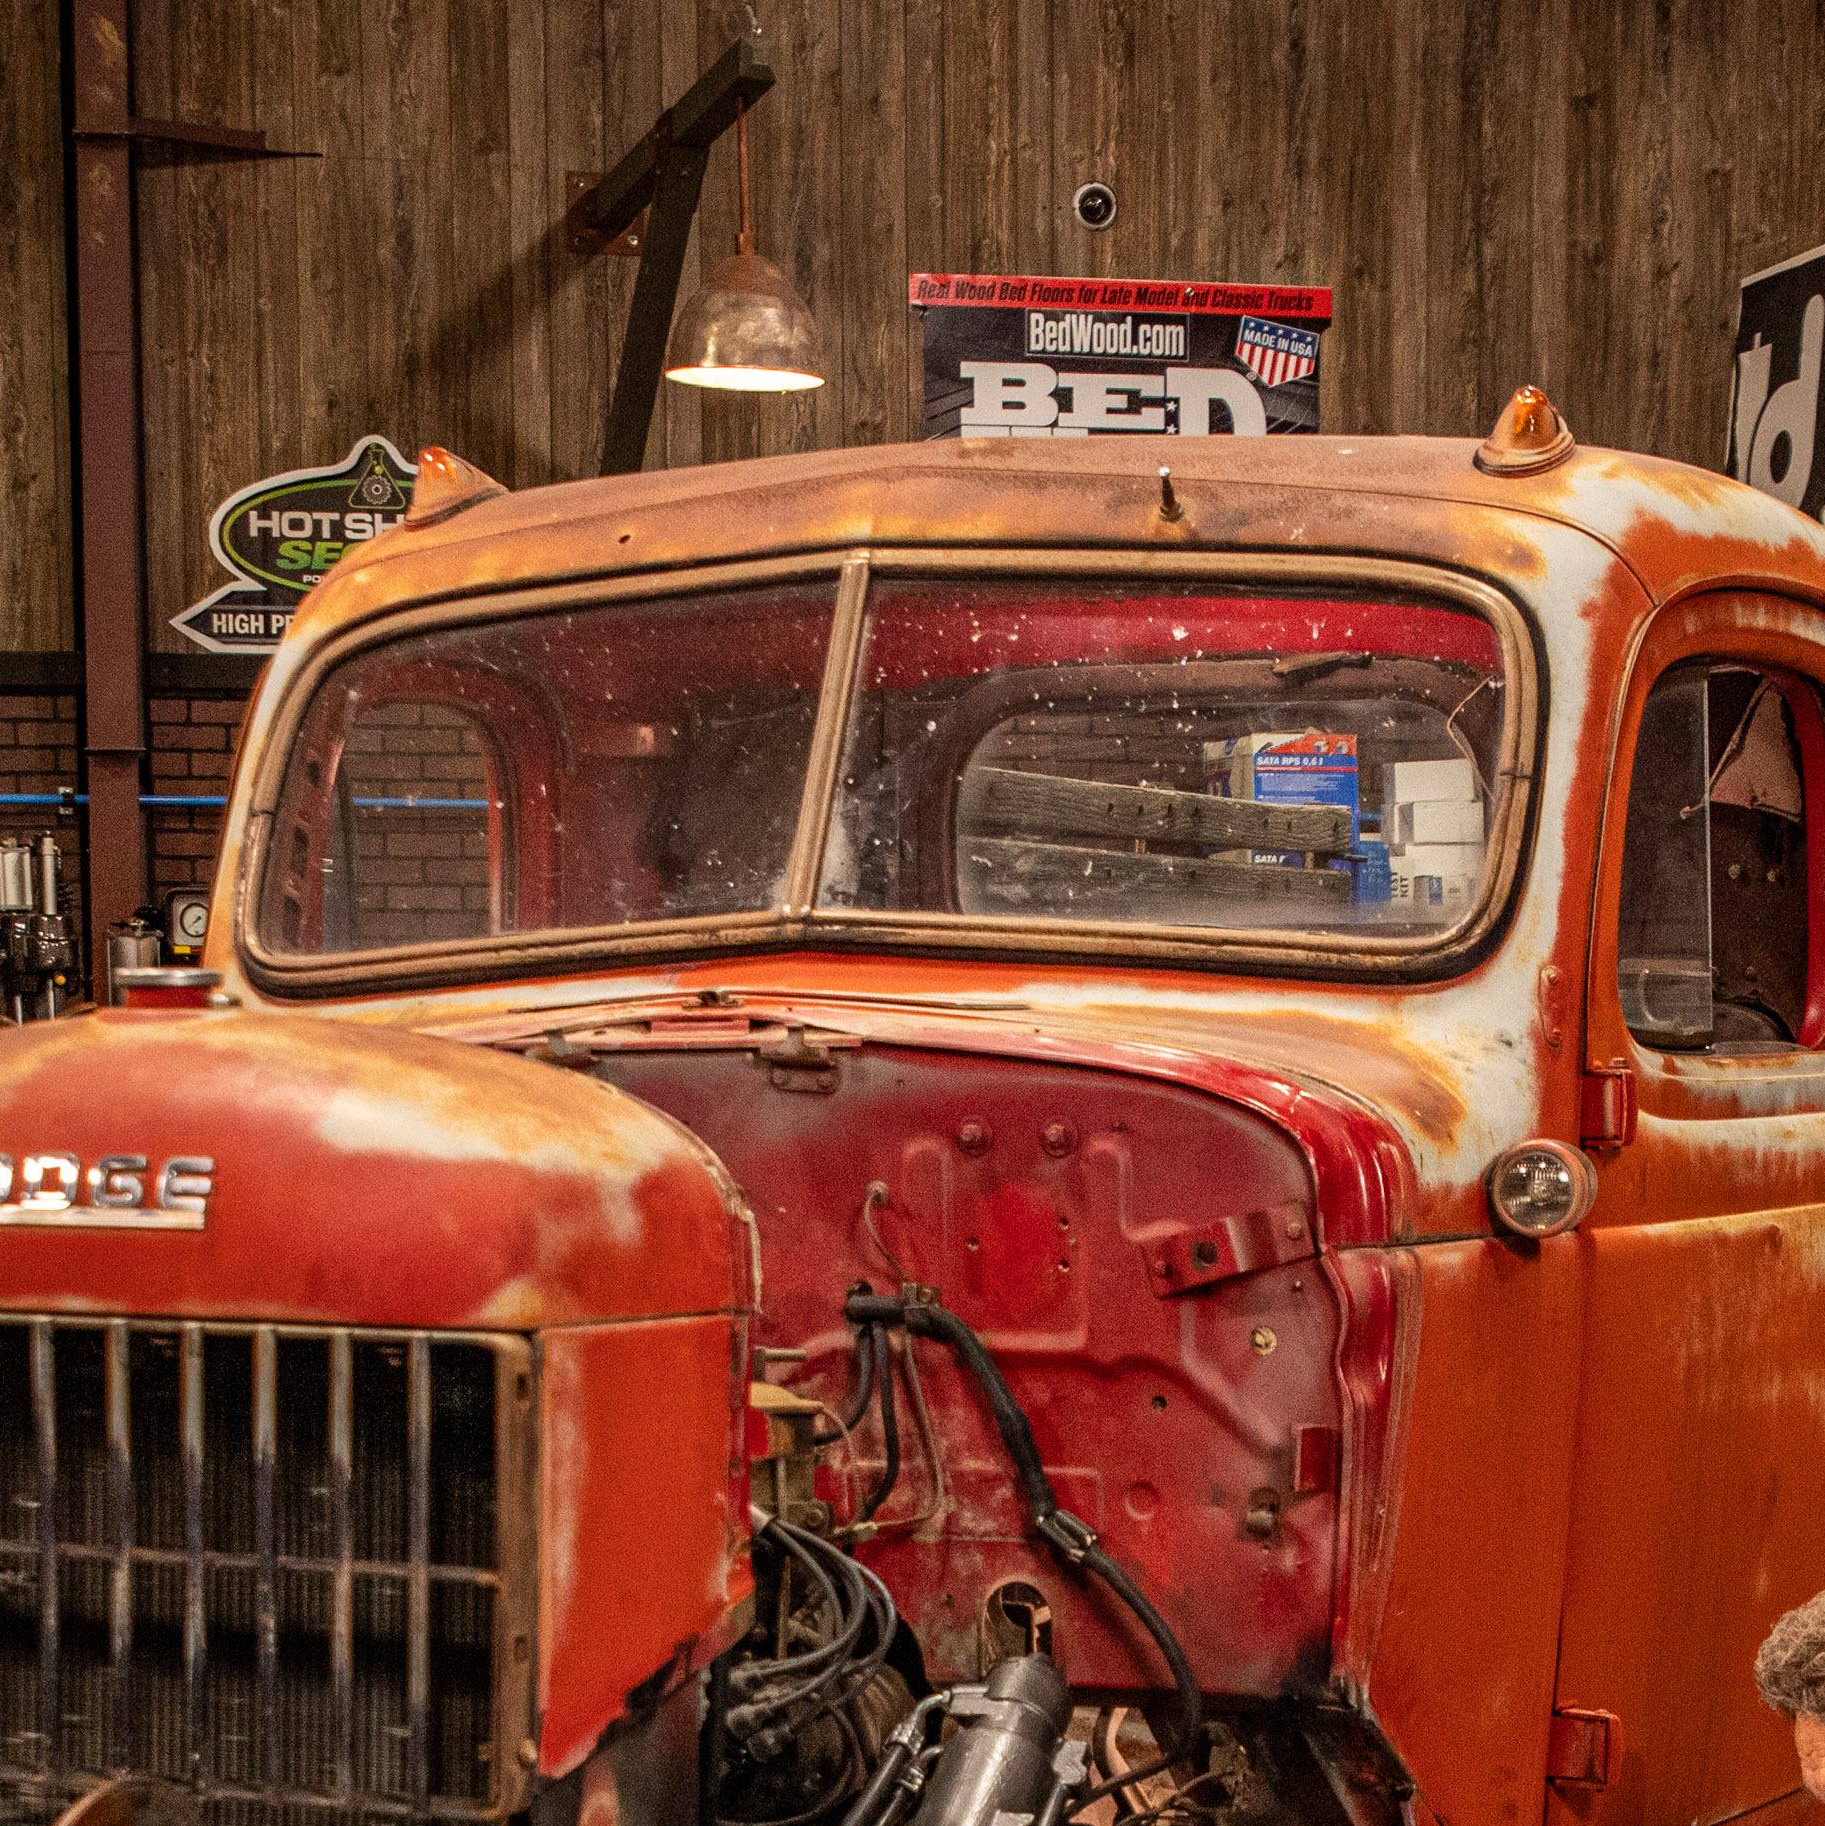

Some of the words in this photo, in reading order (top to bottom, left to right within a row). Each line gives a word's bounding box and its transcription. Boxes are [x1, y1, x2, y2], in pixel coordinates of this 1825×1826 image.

[918, 279, 950, 299] Real
[955, 281, 996, 301] Wood
[999, 282, 1028, 301] Bed
[1030, 283, 1073, 303] Floors
[1078, 285, 1098, 303] for
[1101, 285, 1132, 304] Late
[1135, 286, 1179, 306] Model
[1182, 288, 1209, 307] and
[1211, 289, 1264, 309] Classic
[1267, 291, 1314, 311] Trucks
[1029, 313, 1185, 358] BedWood.com
[1243, 324, 1276, 347] MADE
[1277, 332, 1289, 350] IN
[1291, 335, 1313, 358] USA
[960, 361, 1267, 436] BED
[248, 510, 340, 538] HOT
[212, 613, 264, 635] HIGH
[1257, 757, 1280, 766] SATA
[1281, 757, 1301, 766] RPS
[1254, 854, 1276, 864] SATA
[1400, 875, 1409, 898] KIT
